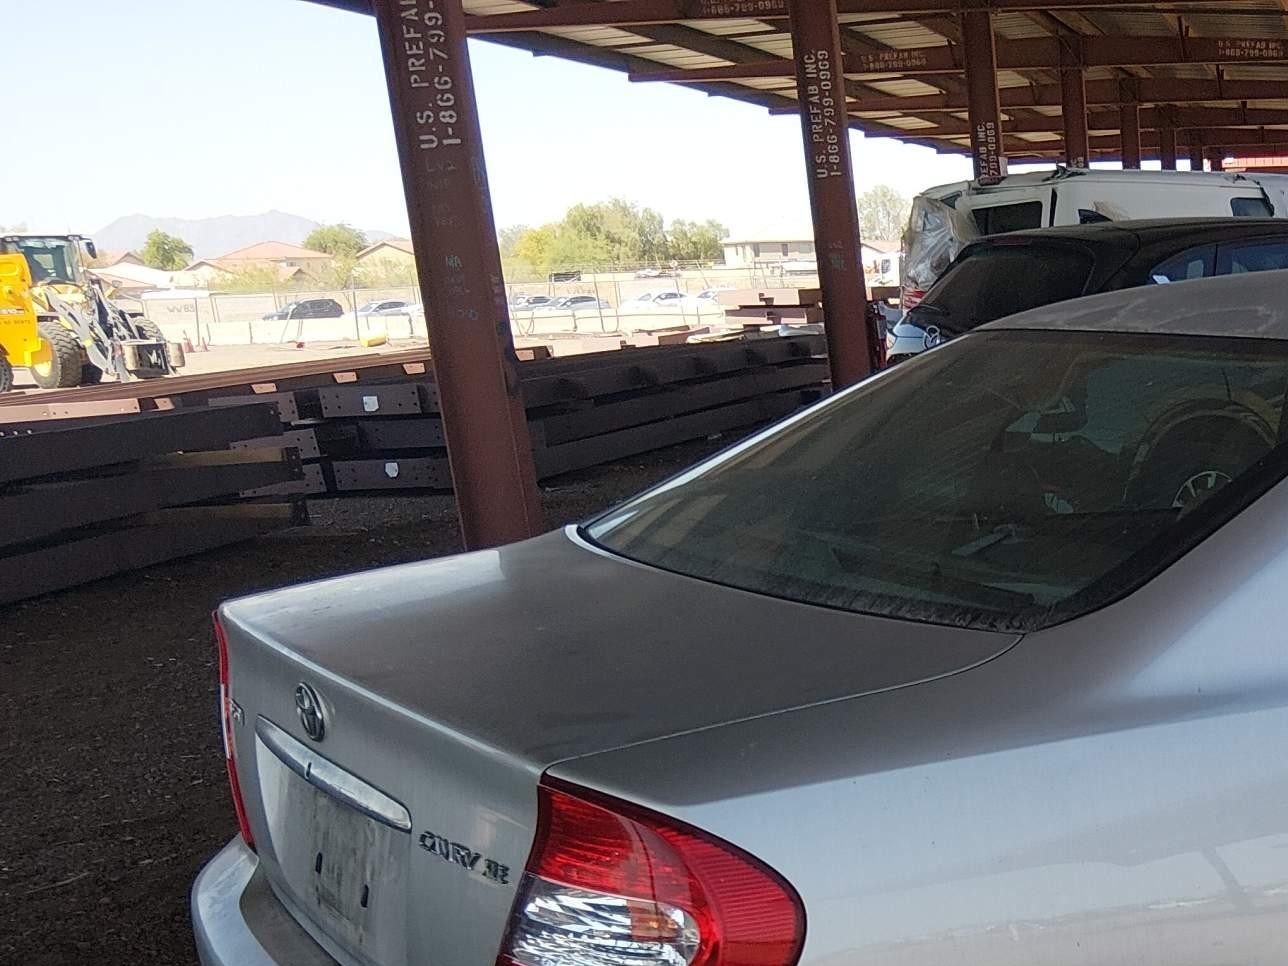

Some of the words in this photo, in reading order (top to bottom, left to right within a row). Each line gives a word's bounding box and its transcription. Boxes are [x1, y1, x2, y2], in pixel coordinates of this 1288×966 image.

[803, 50, 817, 78] INC.
[416, 102, 438, 149] U.S.
[807, 85, 825, 142] PREFAB
[815, 150, 828, 178] U.S.
